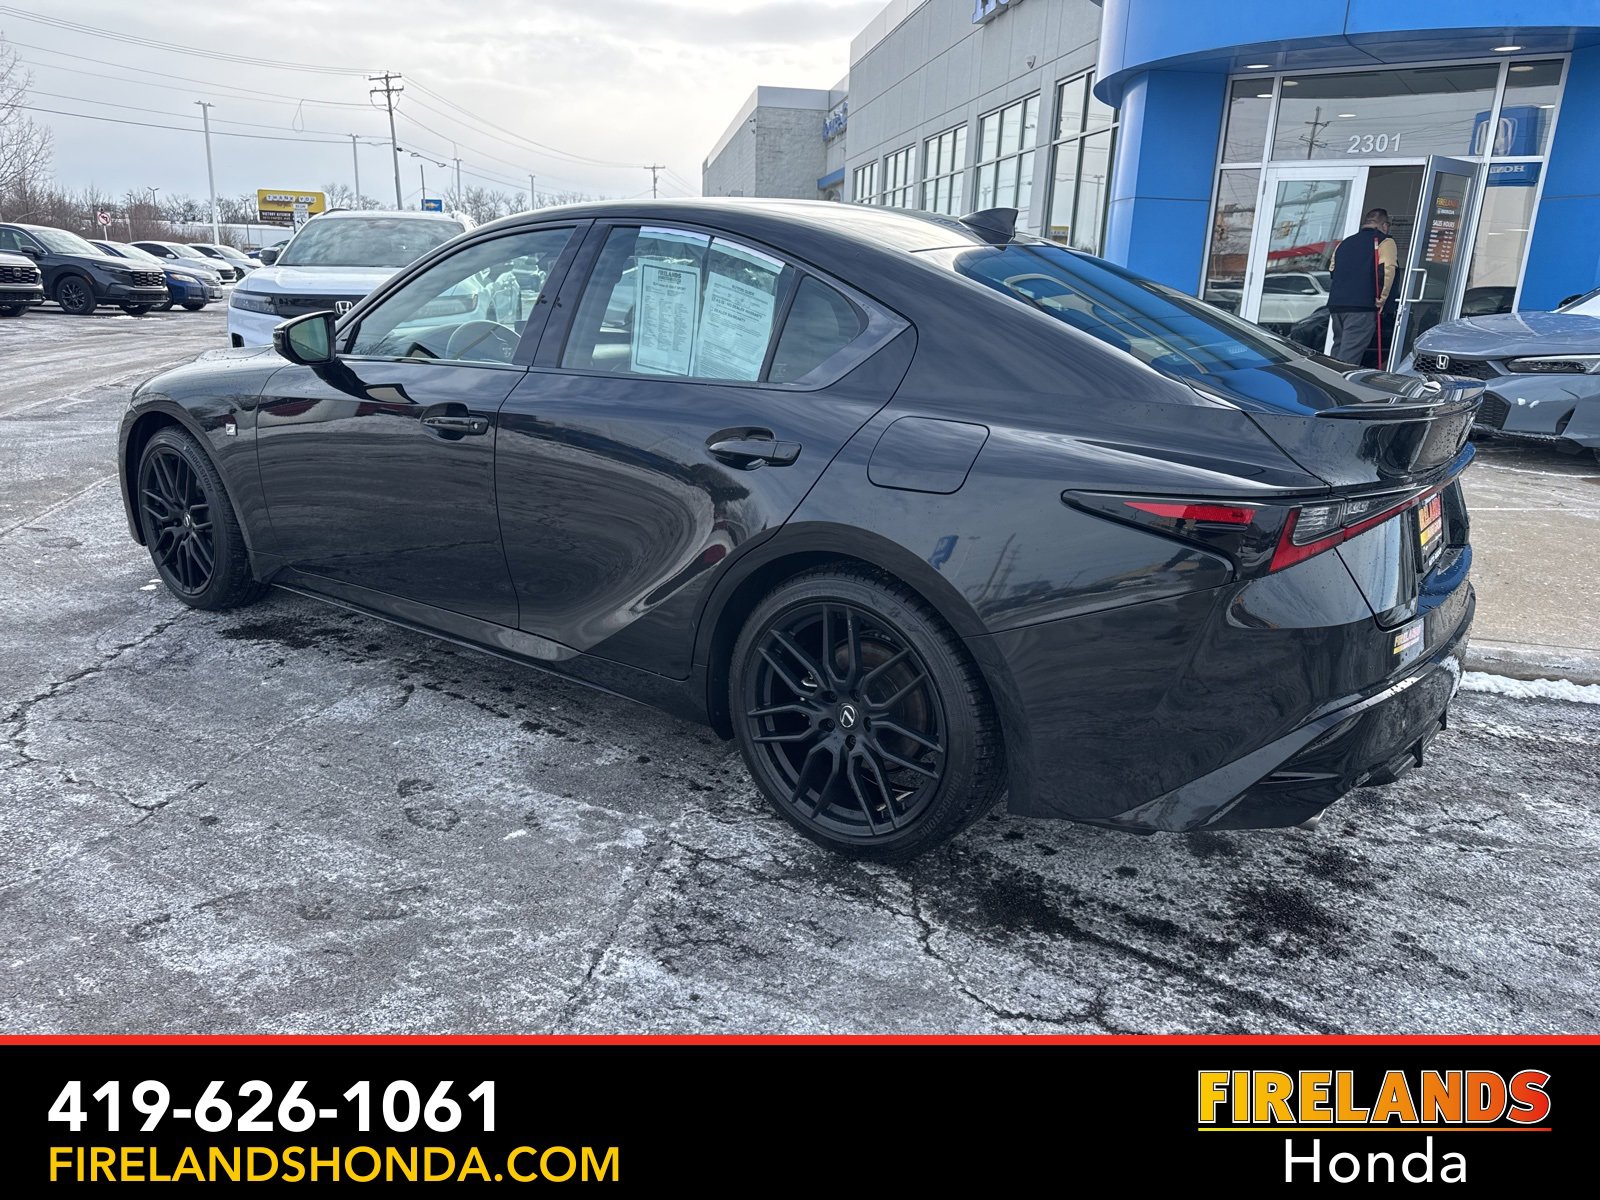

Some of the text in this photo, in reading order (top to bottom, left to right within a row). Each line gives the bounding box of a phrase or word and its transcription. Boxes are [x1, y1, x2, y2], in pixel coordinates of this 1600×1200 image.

[1347, 133, 1401, 153] 2301
[267, 194, 294, 202] THANK
[185, 445, 214, 492] BRIDGESTONE
[918, 770, 962, 838] BRIDGESTONE
